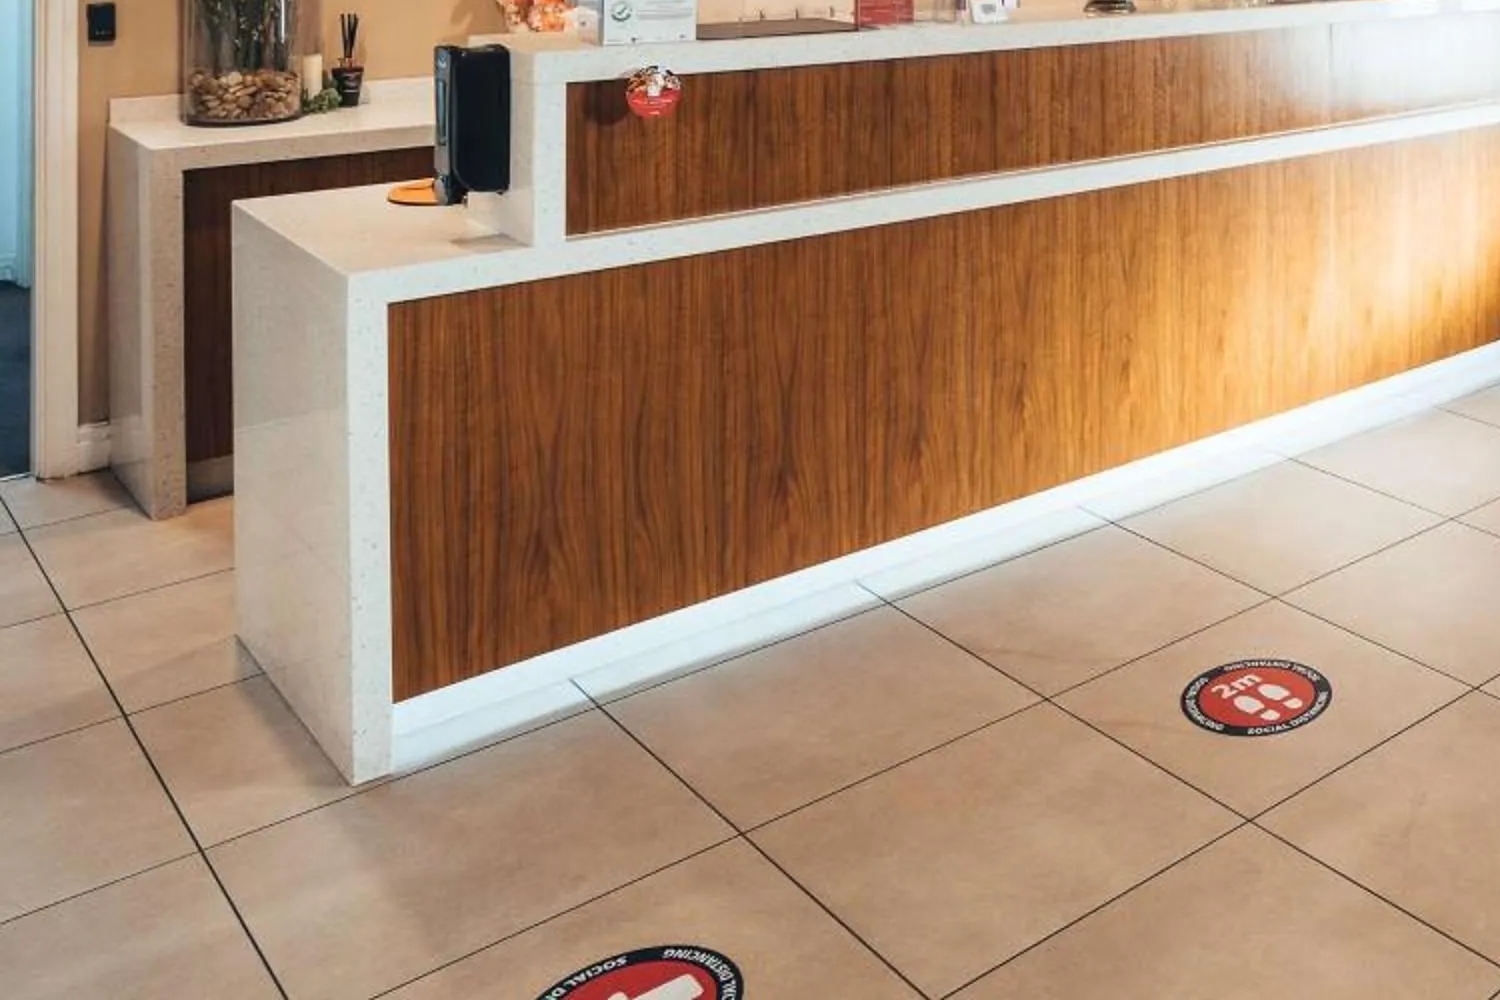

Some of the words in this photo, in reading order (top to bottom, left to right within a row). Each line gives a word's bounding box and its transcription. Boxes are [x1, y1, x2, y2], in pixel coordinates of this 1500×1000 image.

[1210, 673, 1264, 700] 2m
[565, 955, 629, 987] SOCIAL
[662, 948, 735, 981] DISTANCING
